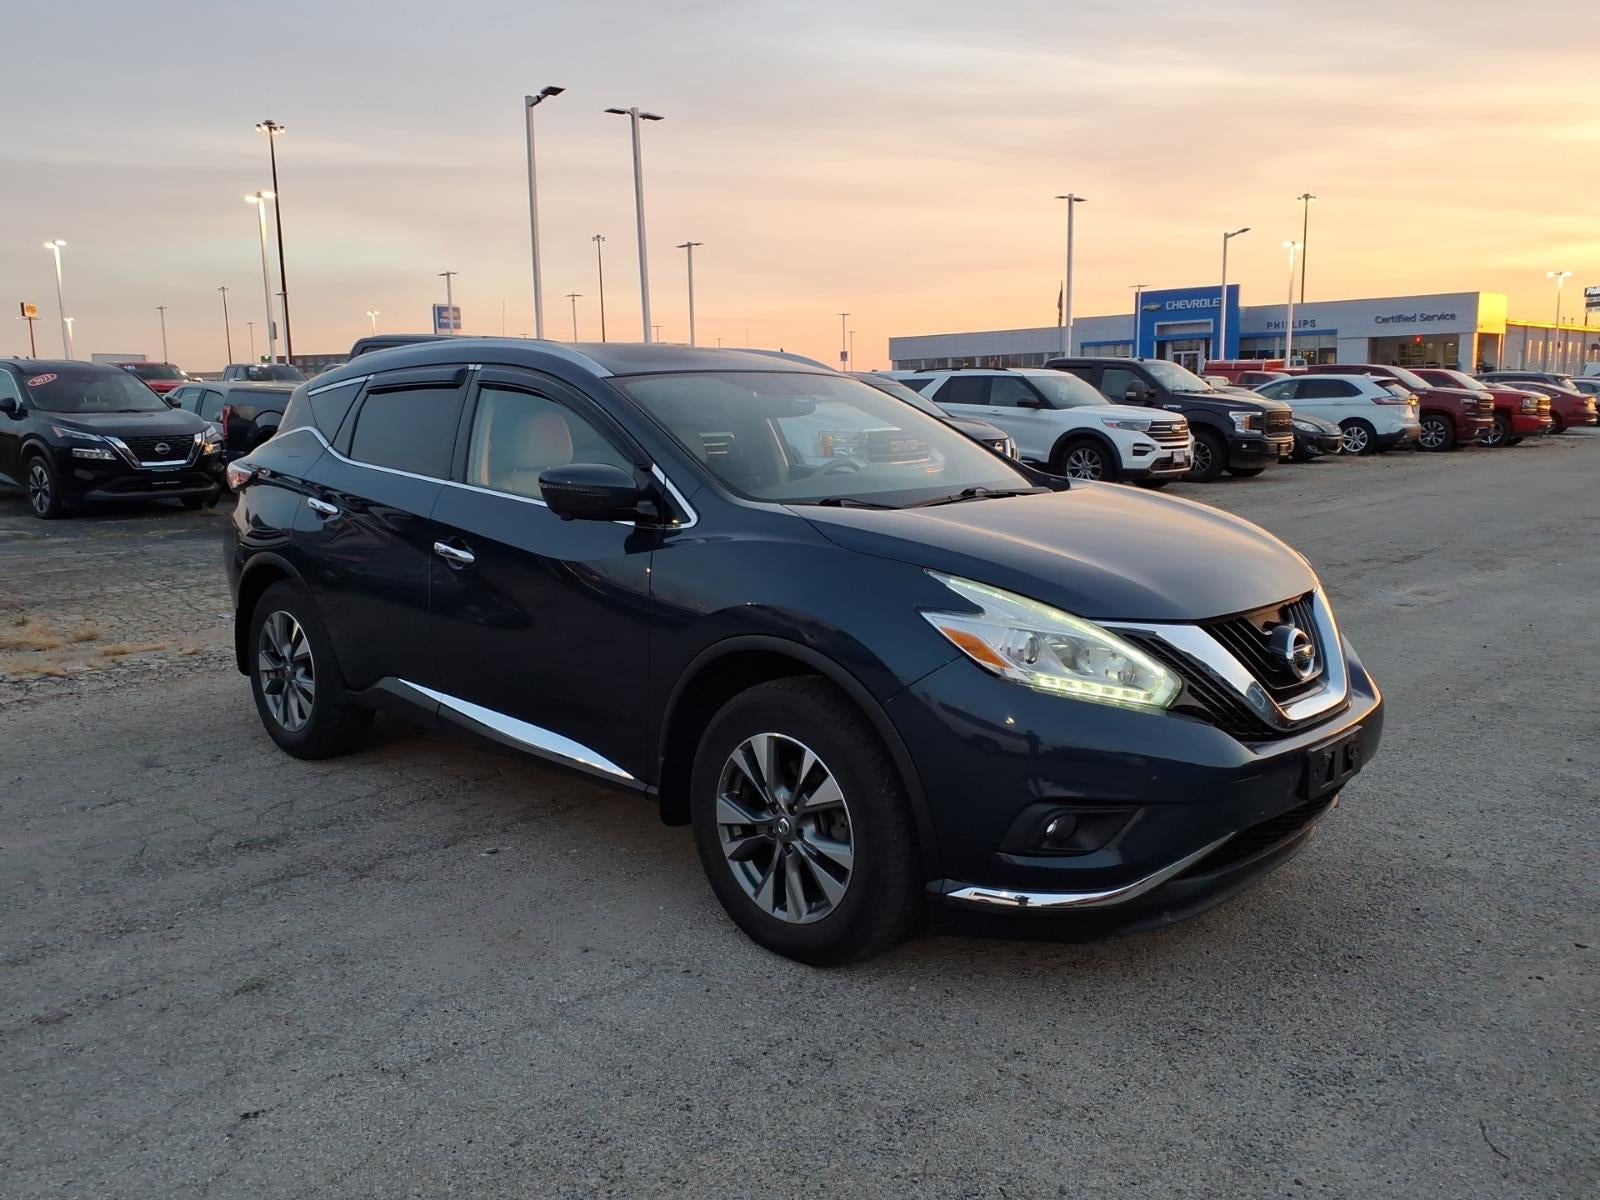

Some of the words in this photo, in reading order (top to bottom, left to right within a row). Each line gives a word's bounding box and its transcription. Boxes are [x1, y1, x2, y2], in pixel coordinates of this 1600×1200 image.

[1166, 297, 1222, 310] CHEVROLE
[1375, 313, 1417, 324] Certified
[1419, 312, 1456, 322] Service
